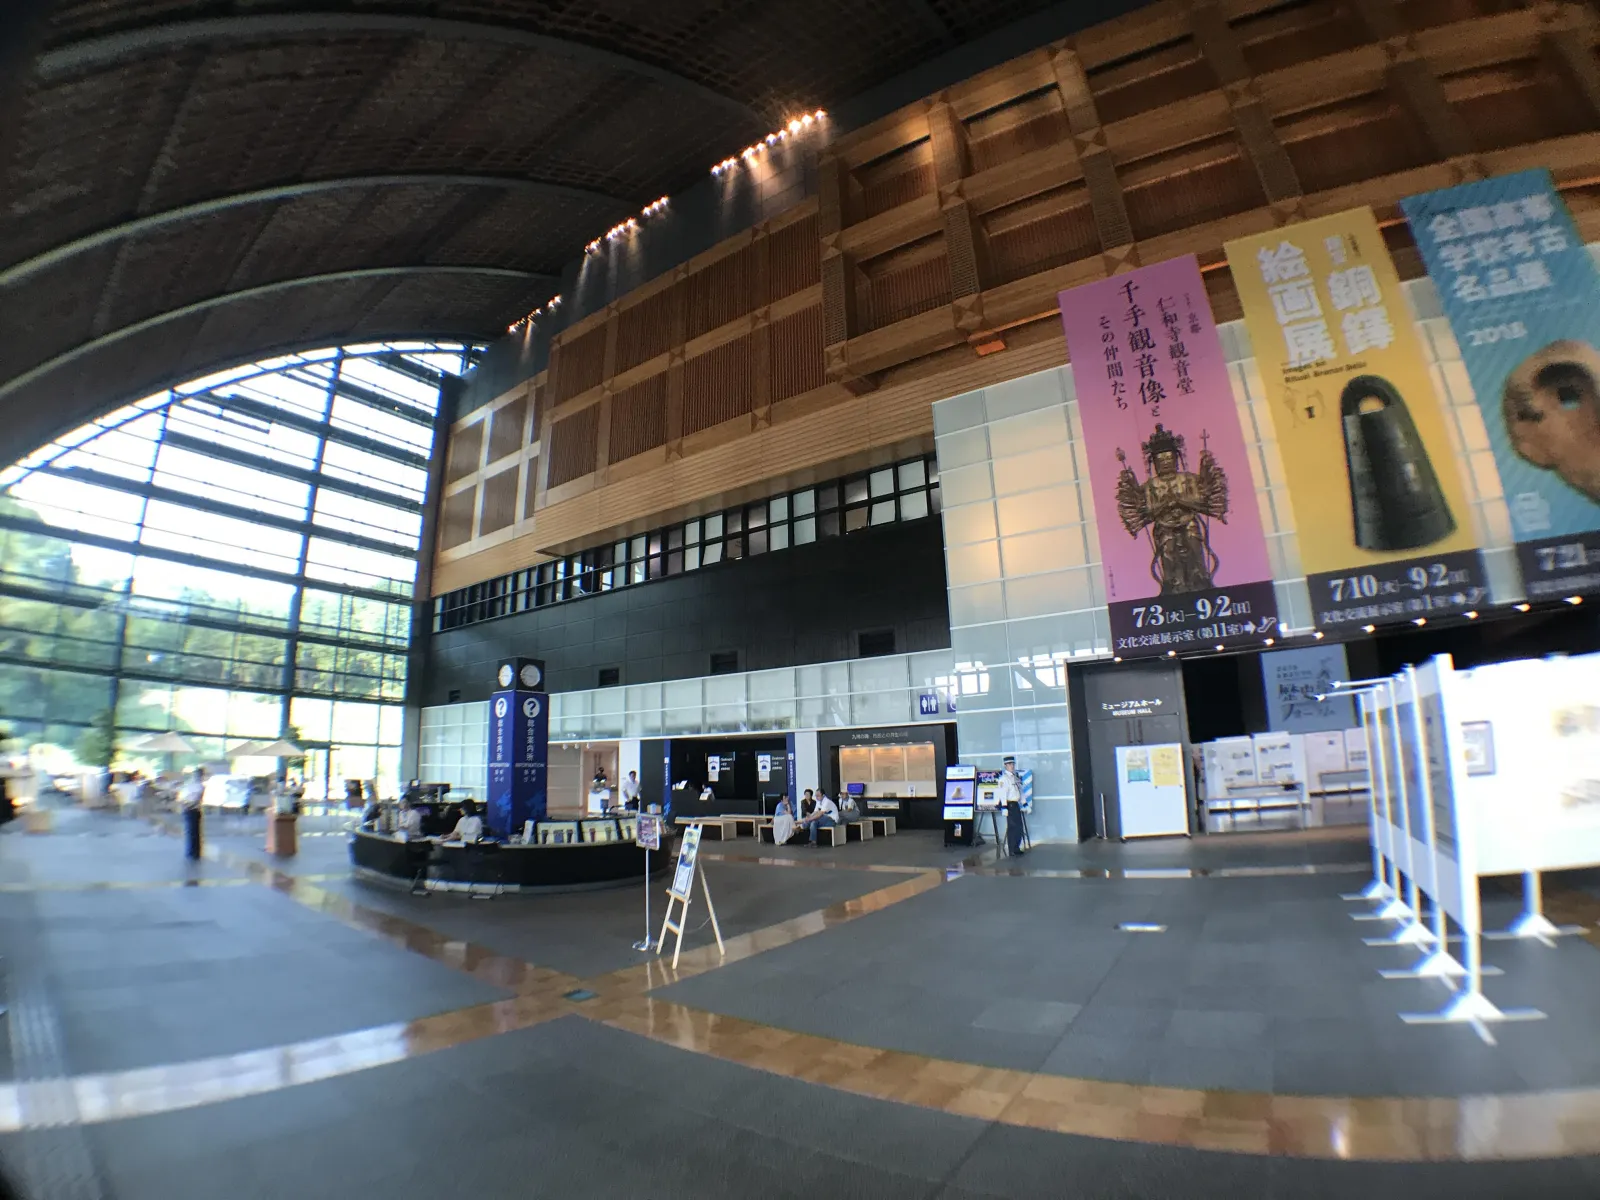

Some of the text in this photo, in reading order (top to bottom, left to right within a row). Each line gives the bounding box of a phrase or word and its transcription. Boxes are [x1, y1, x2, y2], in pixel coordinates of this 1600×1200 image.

[1117, 280, 1167, 417] 千手観音像と
[1156, 296, 1195, 396] 仁和寺観音堂
[1257, 241, 1337, 367] 絵画展
[1099, 316, 1128, 410] その仲間たち
[1102, 698, 1163, 710] ミュージアムホール
